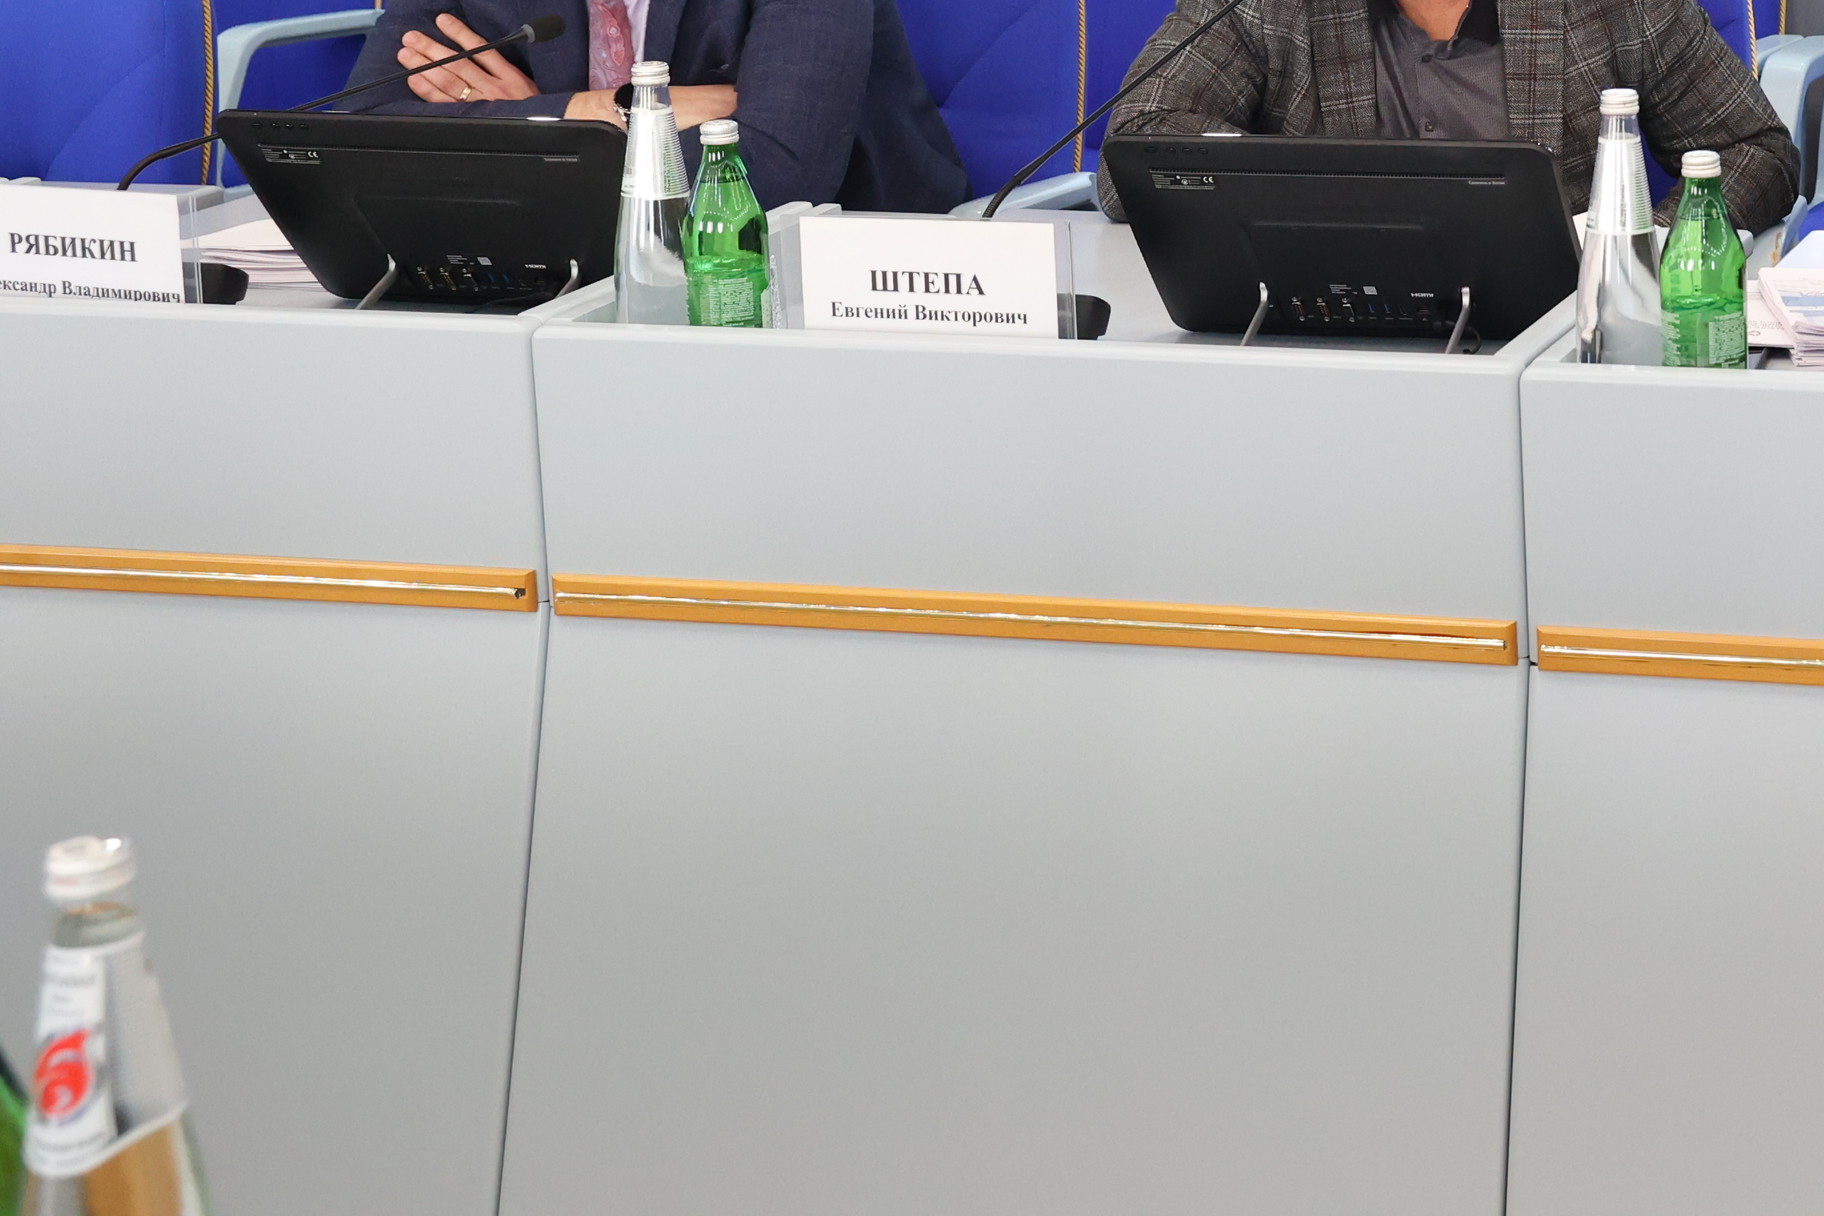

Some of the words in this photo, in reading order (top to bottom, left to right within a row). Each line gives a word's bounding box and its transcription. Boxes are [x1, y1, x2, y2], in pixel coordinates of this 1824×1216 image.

[8, 232, 139, 263] РЯБИКИН
[0, 279, 57, 299] ксандр
[61, 280, 181, 304] Владимирович
[870, 269, 987, 296] ШТЕПА
[831, 301, 909, 321] Евгений
[915, 304, 1028, 327] Викторович
